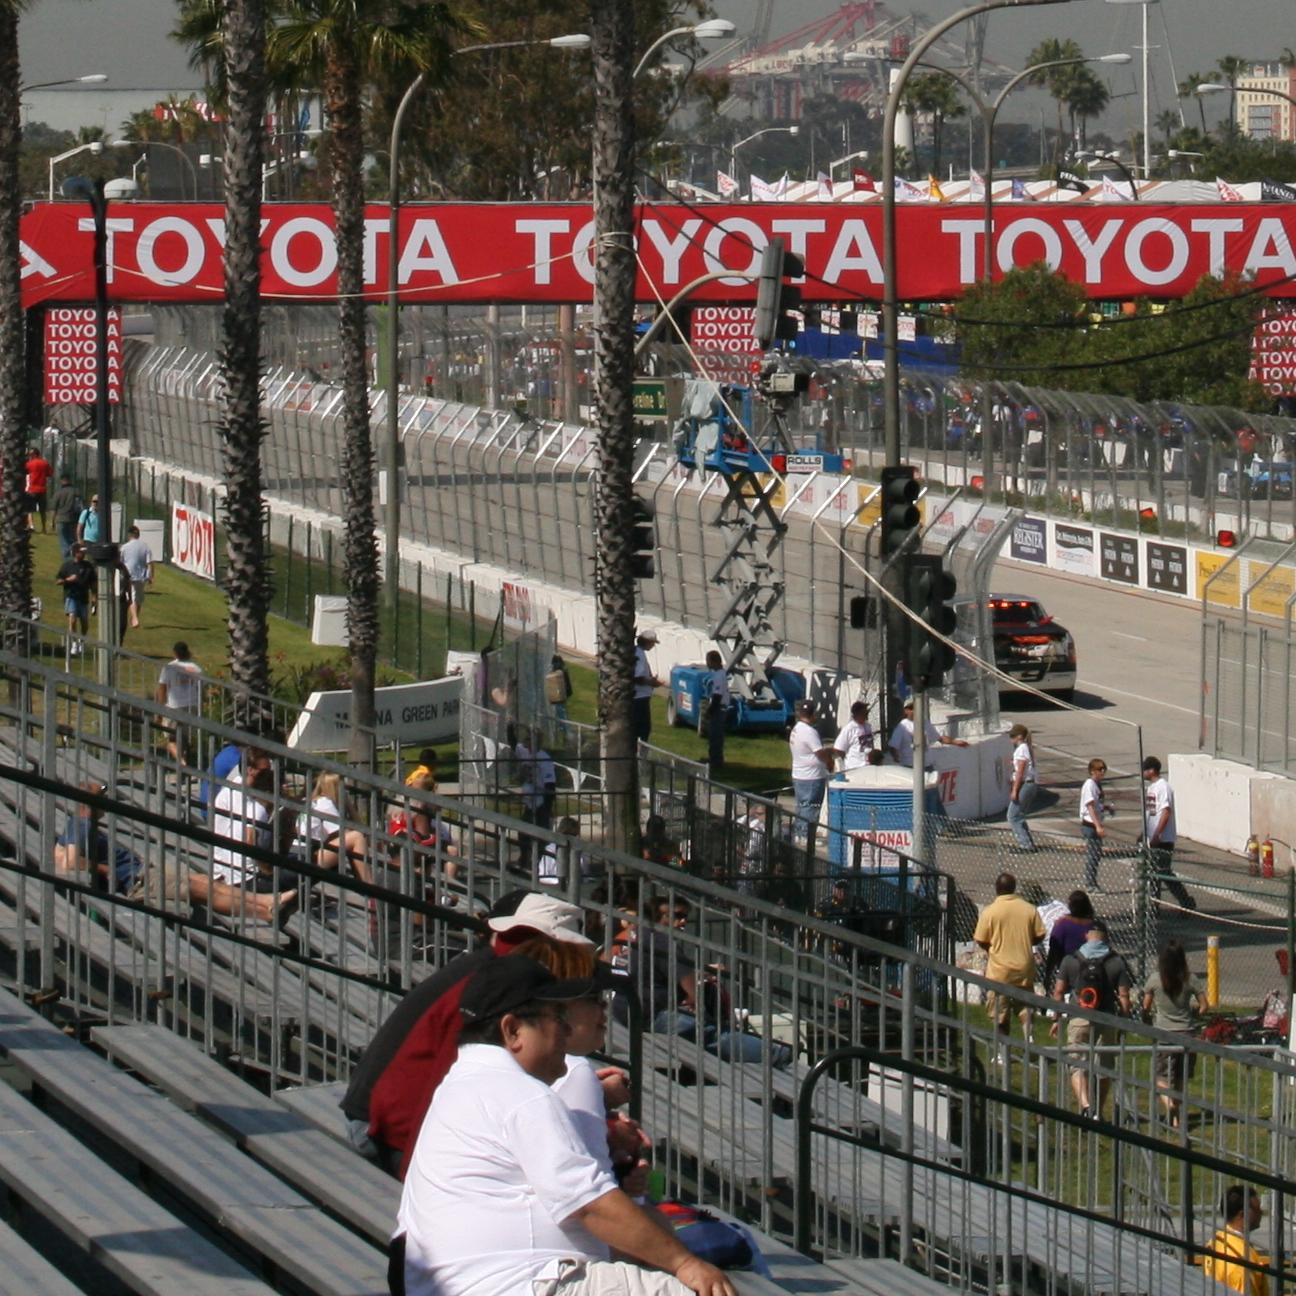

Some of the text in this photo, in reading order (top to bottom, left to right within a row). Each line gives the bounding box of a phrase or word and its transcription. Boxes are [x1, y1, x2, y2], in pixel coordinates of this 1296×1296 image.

[48, 308, 119, 321] TOYOA
[48, 324, 119, 337] TOYOA
[48, 340, 119, 354] TOYOA
[48, 356, 119, 370] TOYOA
[48, 372, 119, 386] TOYOA
[48, 388, 119, 402] TOYOA
[402, 703, 438, 724] GREEN
